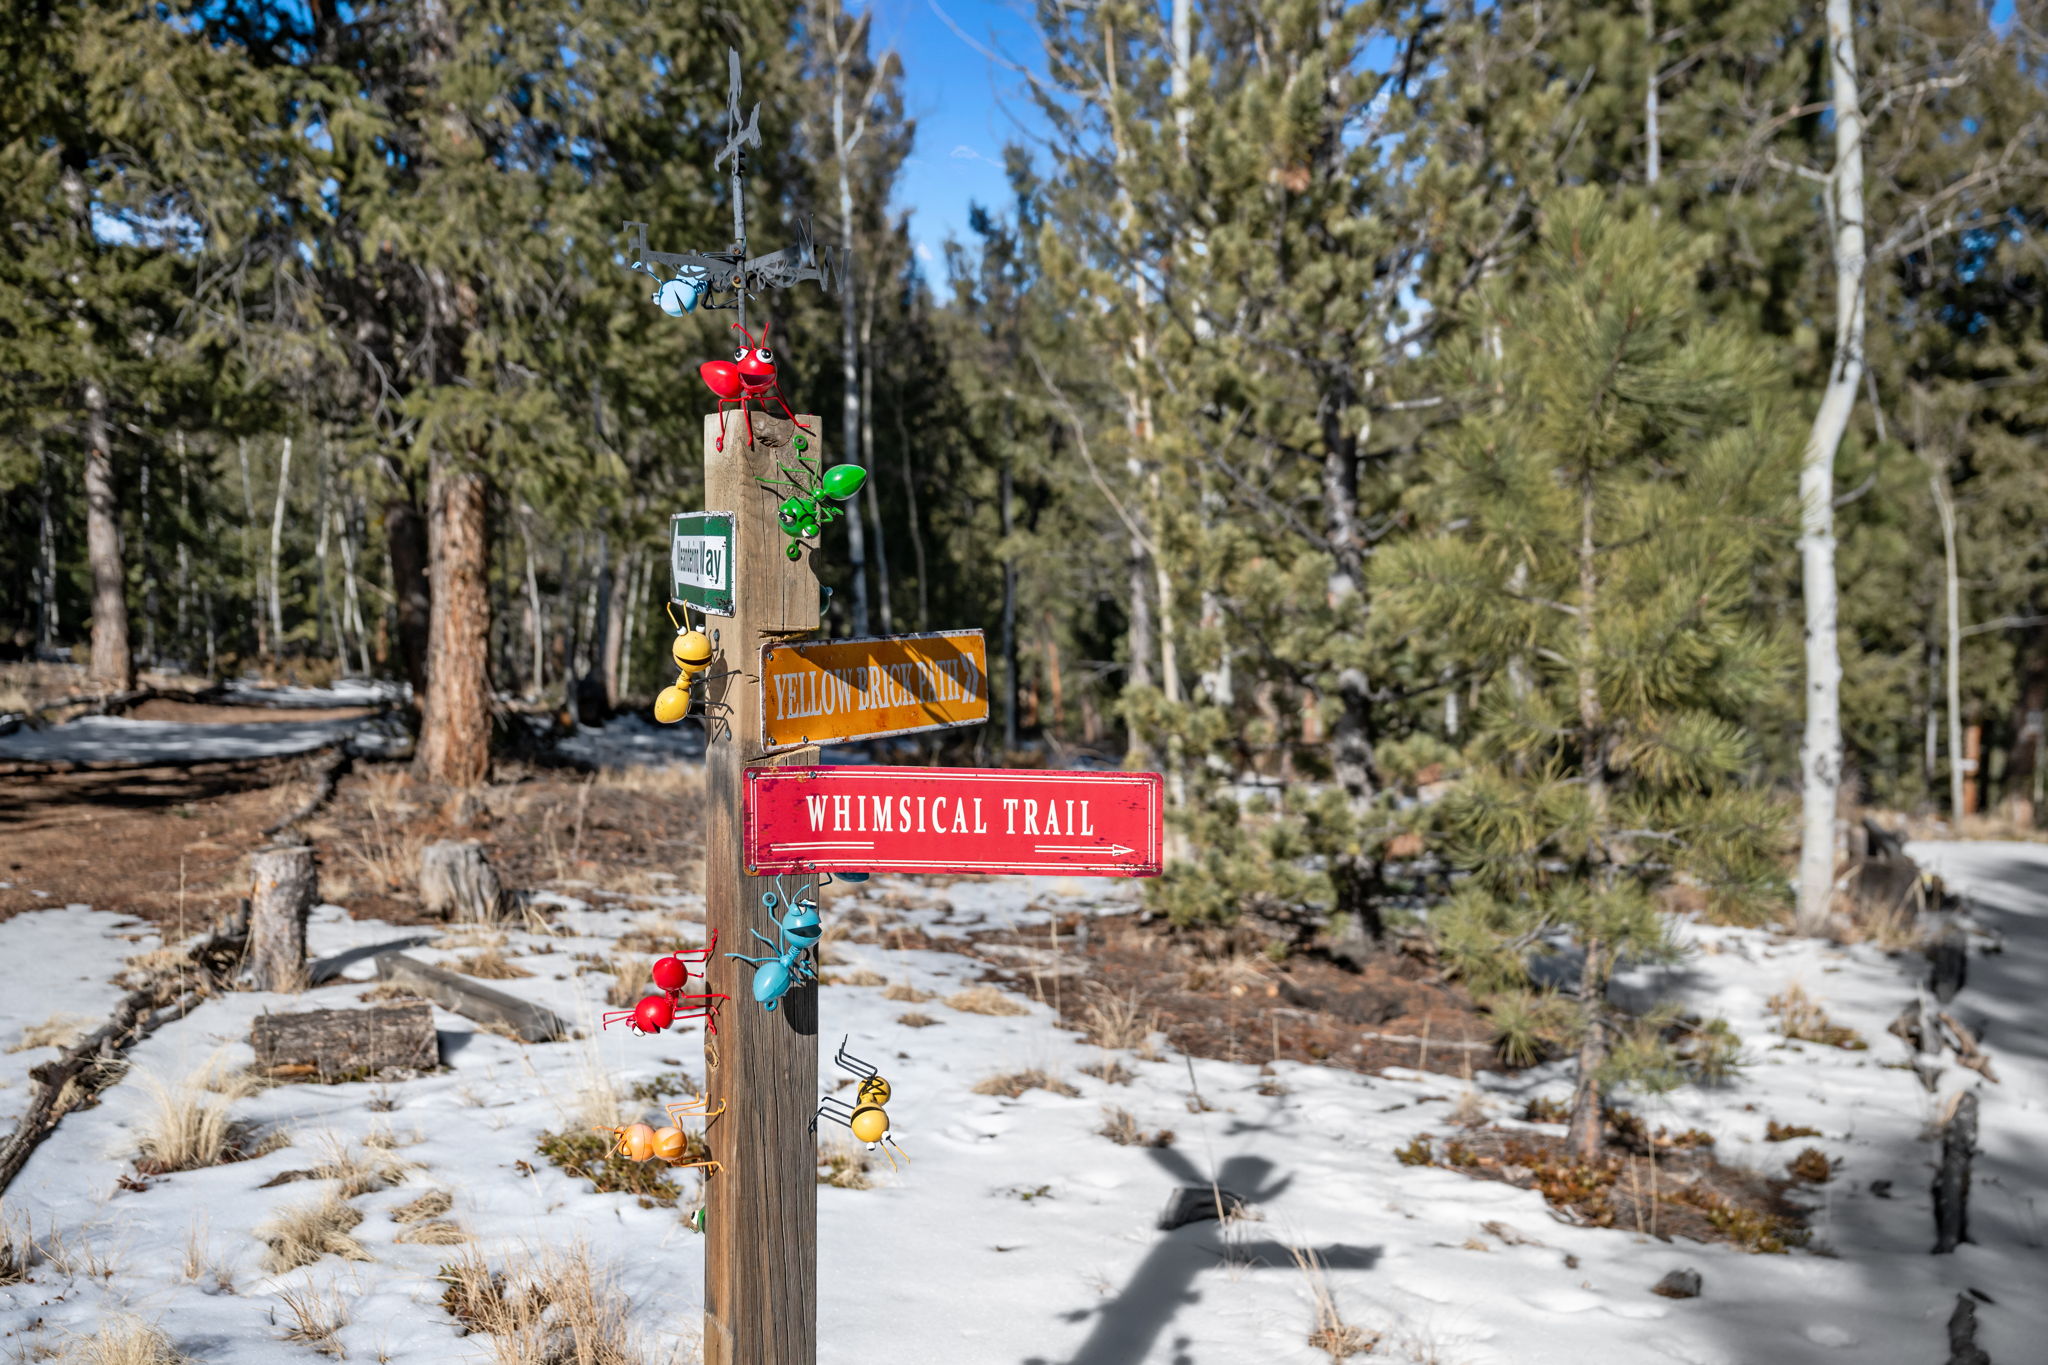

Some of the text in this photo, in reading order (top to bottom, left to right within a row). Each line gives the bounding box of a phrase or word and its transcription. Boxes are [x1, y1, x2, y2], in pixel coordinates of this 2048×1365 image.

[699, 540, 721, 584] Way
[774, 659, 961, 720] YELLOW BRICK PATH
[806, 795, 1094, 837] WHIMSICAL TRAIL
